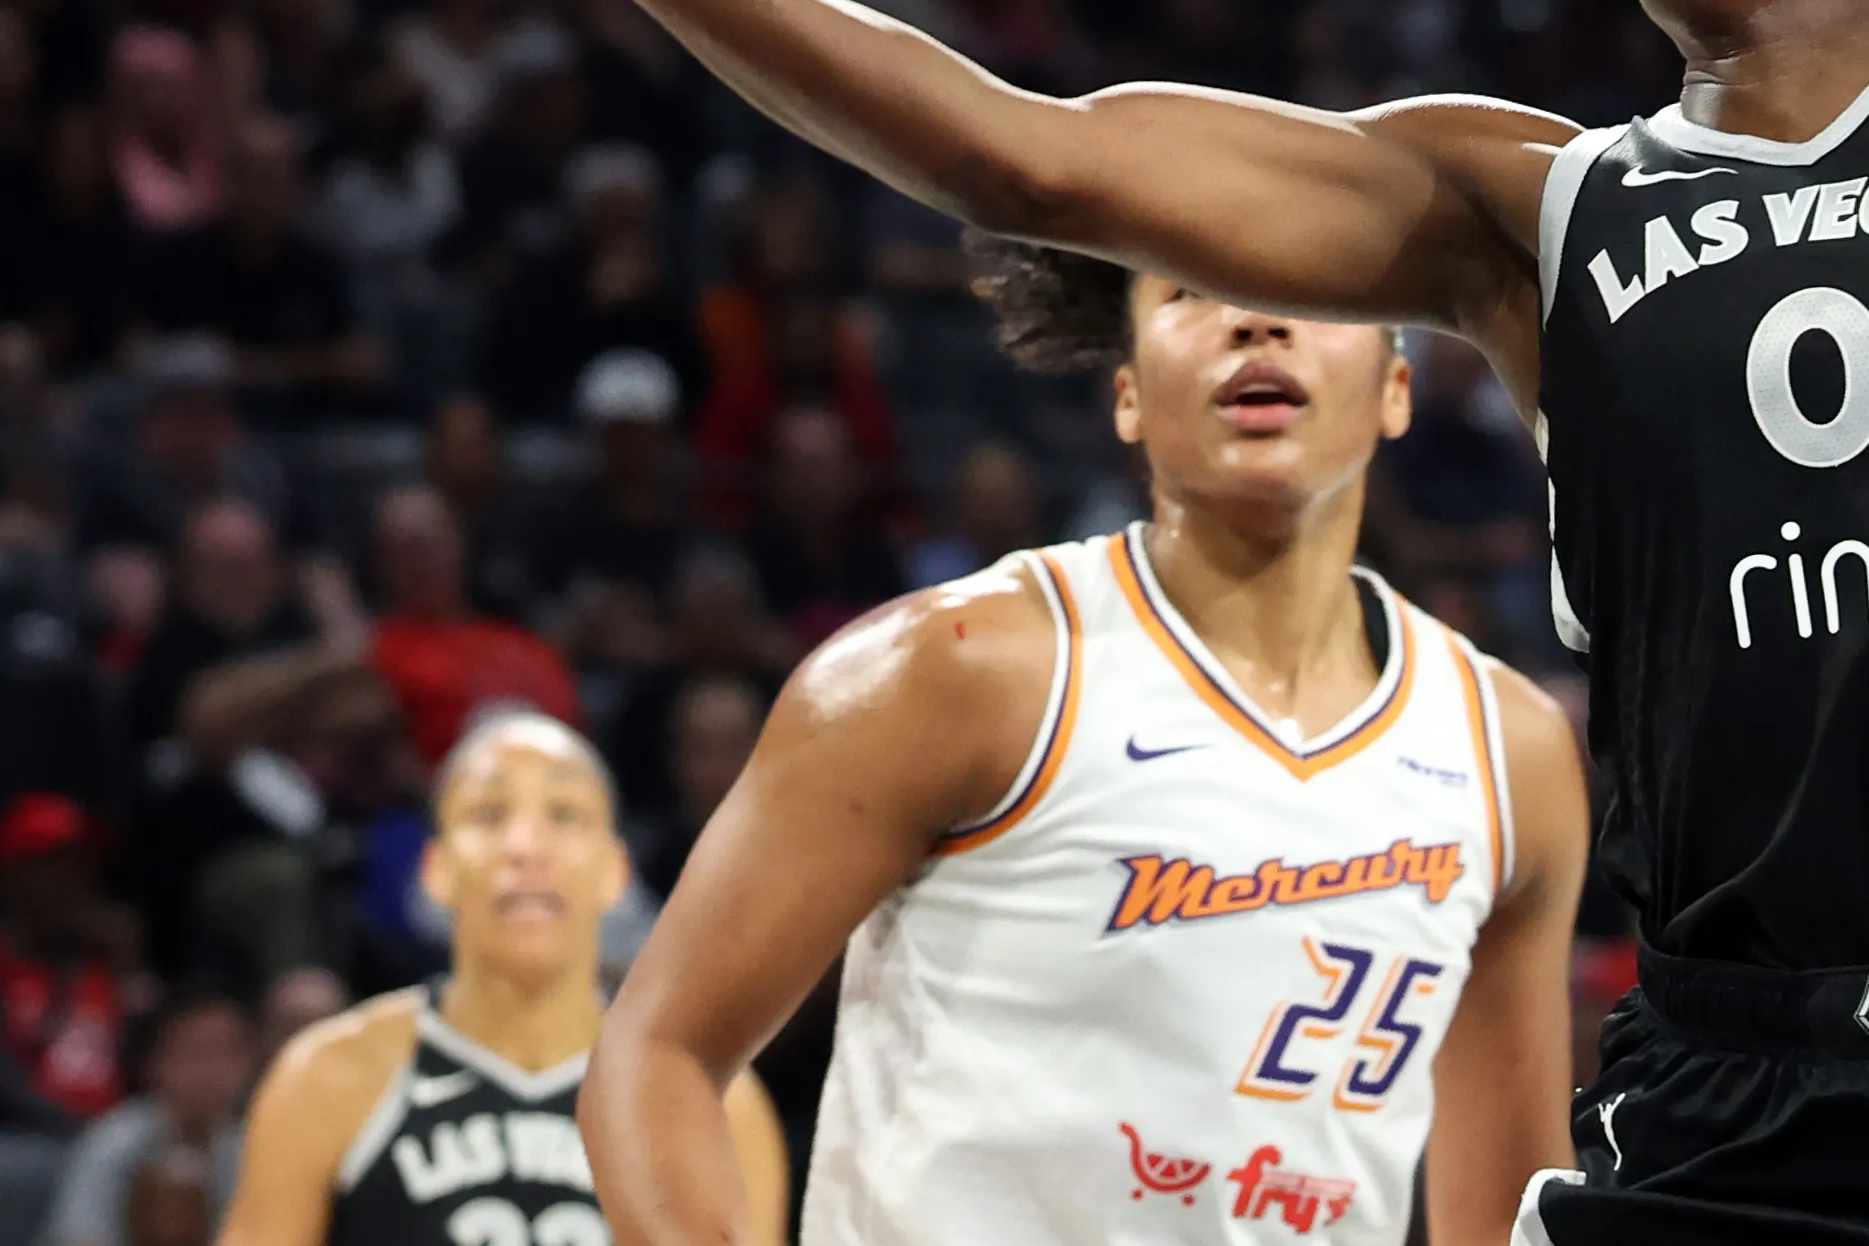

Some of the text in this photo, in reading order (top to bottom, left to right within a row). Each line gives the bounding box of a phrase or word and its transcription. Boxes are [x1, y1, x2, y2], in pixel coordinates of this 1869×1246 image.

[1587, 200, 1749, 324] LAS
[1103, 838, 1464, 934] Mercury
[1234, 936, 1444, 1112] 25
